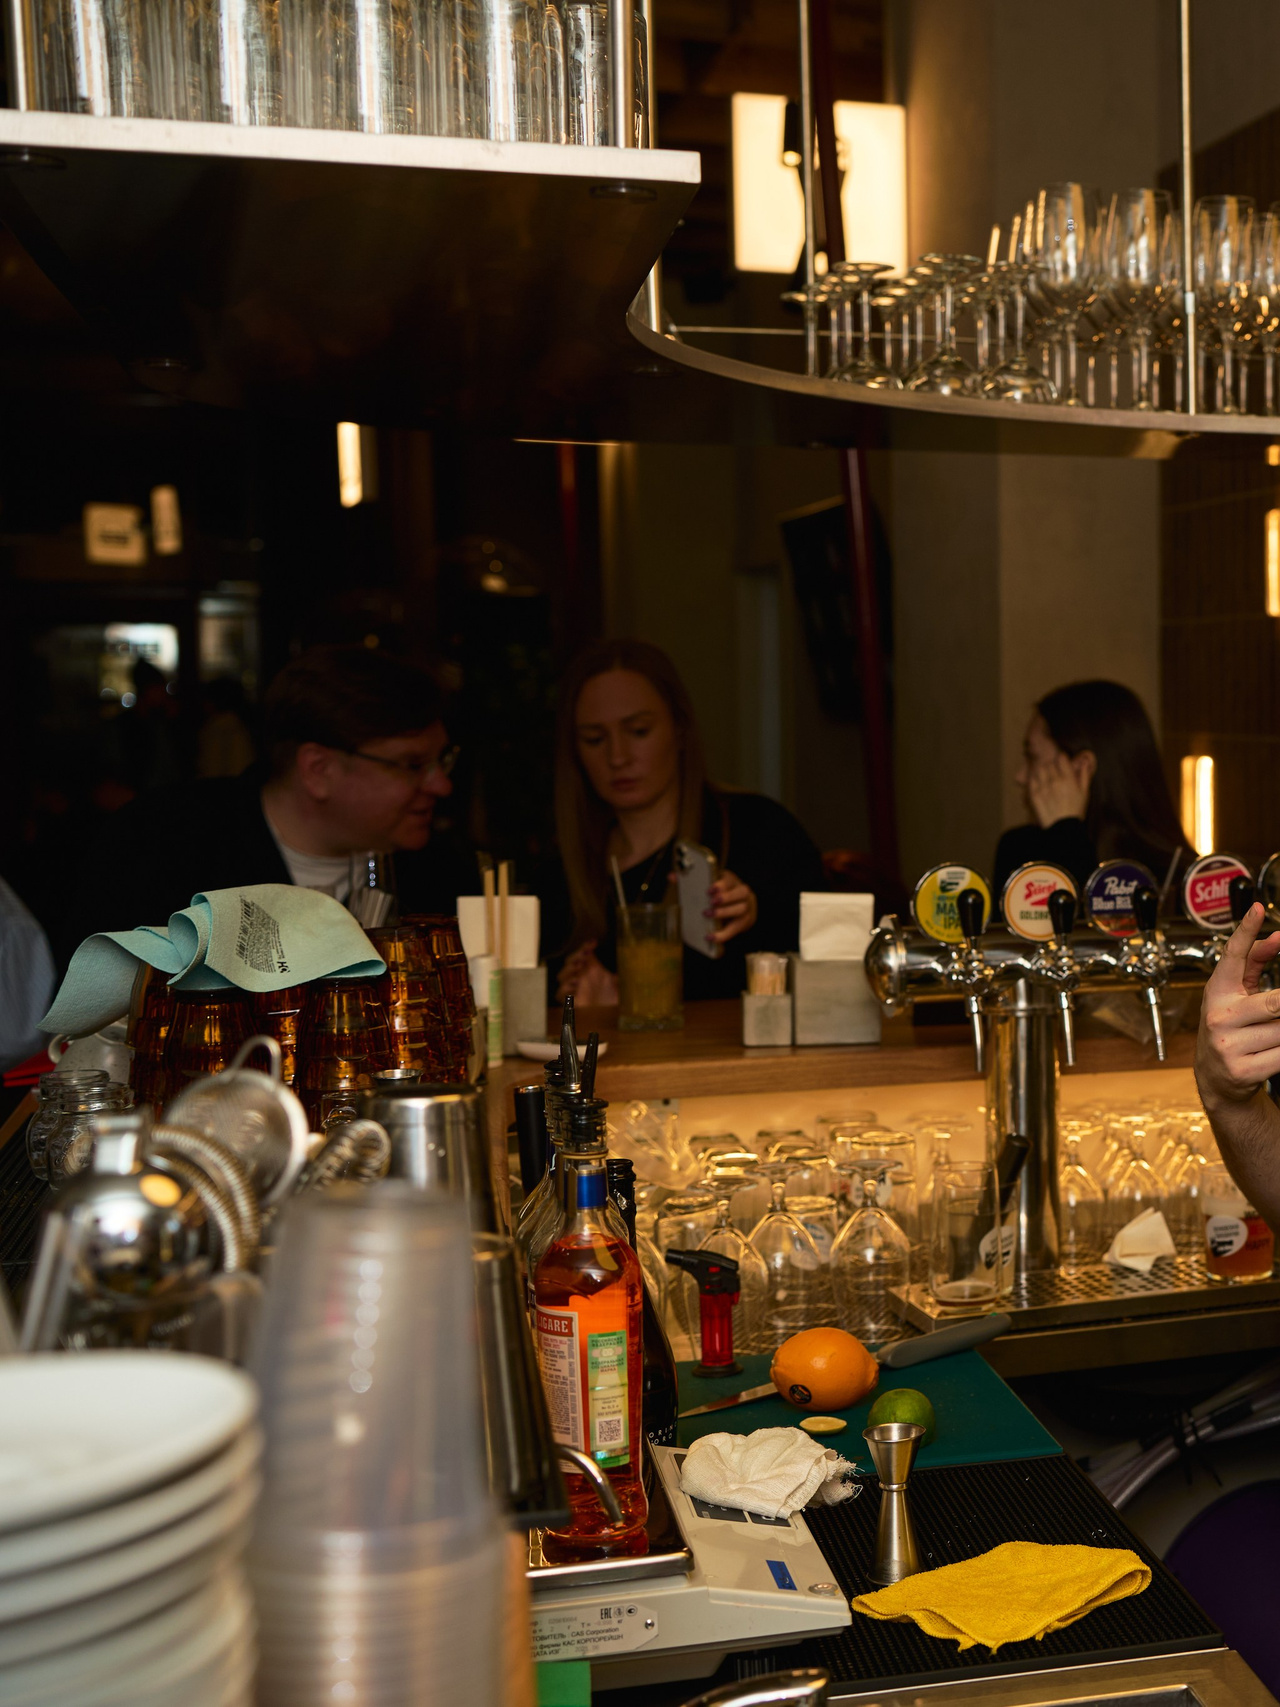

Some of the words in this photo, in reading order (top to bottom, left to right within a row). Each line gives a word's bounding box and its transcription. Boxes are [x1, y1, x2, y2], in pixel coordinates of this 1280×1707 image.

[1104, 876, 1138, 896] Pabst
[1194, 876, 1231, 904] Schli
[1092, 896, 1115, 911] Blue
[571, 1630, 585, 1638] CAS
[586, 1626, 619, 1636] Corporation
[539, 1642, 561, 1651] фирмы
[576, 1633, 624, 1646] КОРПОРЕЙШН
